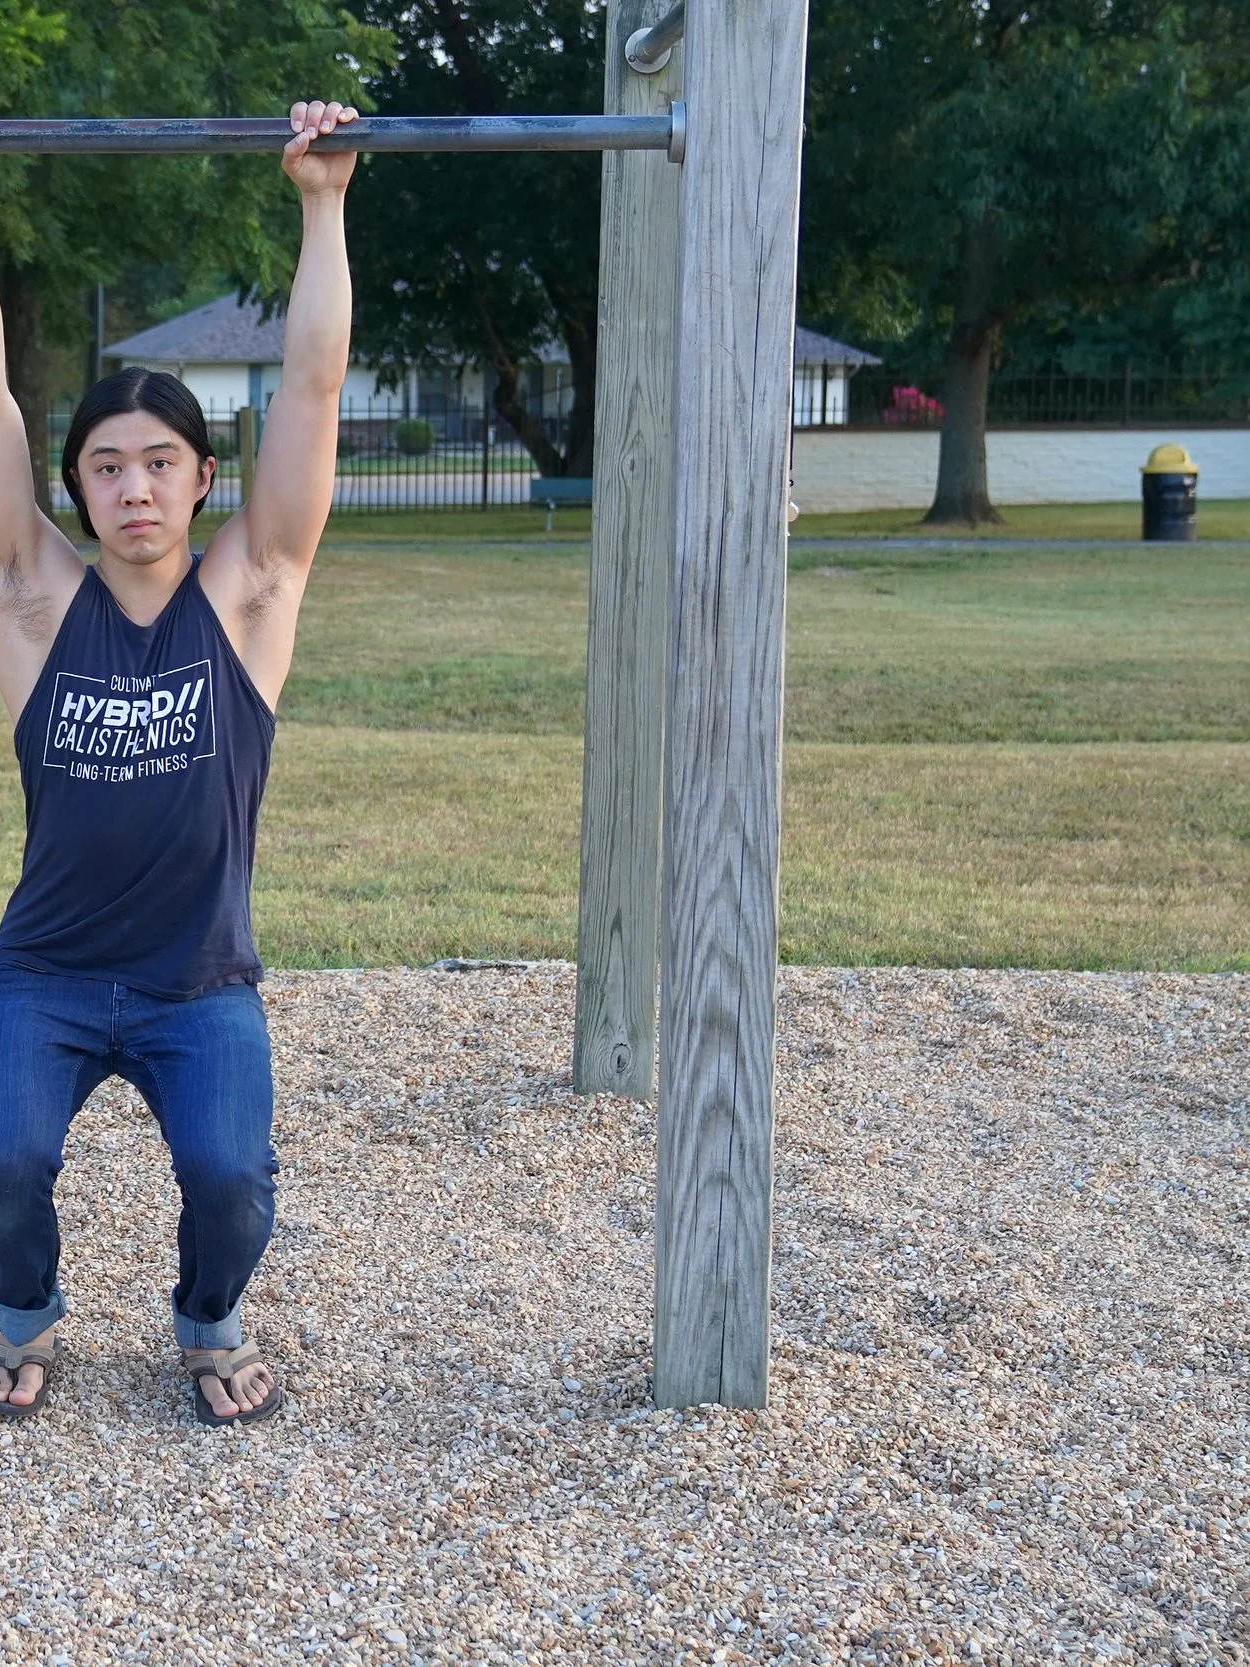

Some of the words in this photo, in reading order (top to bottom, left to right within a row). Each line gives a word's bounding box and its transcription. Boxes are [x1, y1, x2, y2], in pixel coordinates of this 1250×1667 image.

[110, 674, 157, 693] CULTIVAT
[54, 712, 197, 758] CALISTHENICS
[69, 761, 134, 782] LONG-TERM
[138, 753, 188, 778] FITNESS
